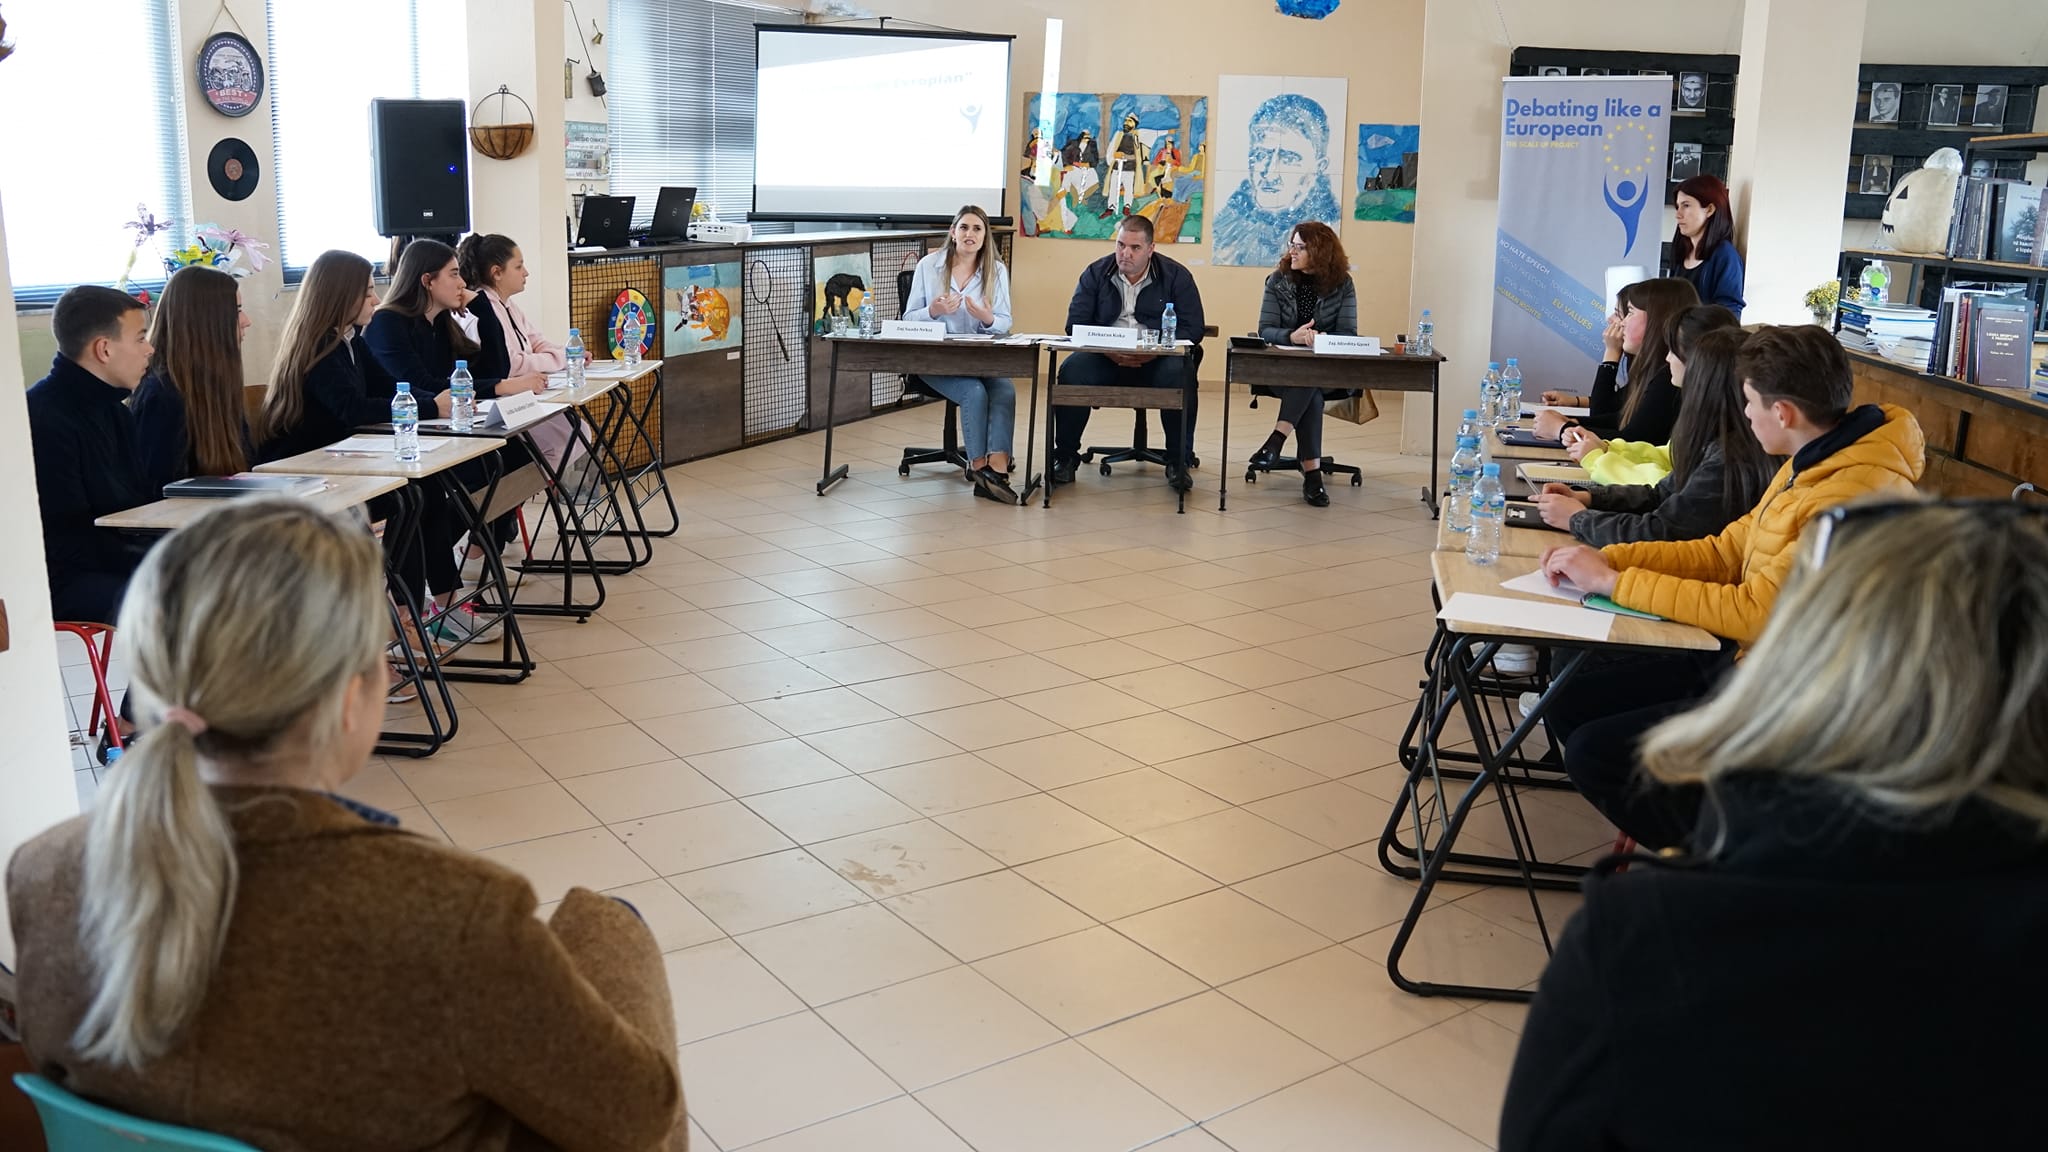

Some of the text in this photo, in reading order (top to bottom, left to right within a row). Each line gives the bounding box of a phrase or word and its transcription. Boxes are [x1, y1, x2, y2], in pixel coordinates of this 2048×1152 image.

[219, 89, 243, 97] BEST
[1506, 98, 1661, 121] Debating like a
[1505, 118, 1603, 141] European
[1550, 141, 1579, 149] PROJECT
[1500, 239, 1510, 249] NO
[1509, 246, 1526, 260] HATE
[1526, 255, 1551, 276] SPEECH
[1552, 297, 1564, 310] EU
[1564, 305, 1593, 331] VALUES
